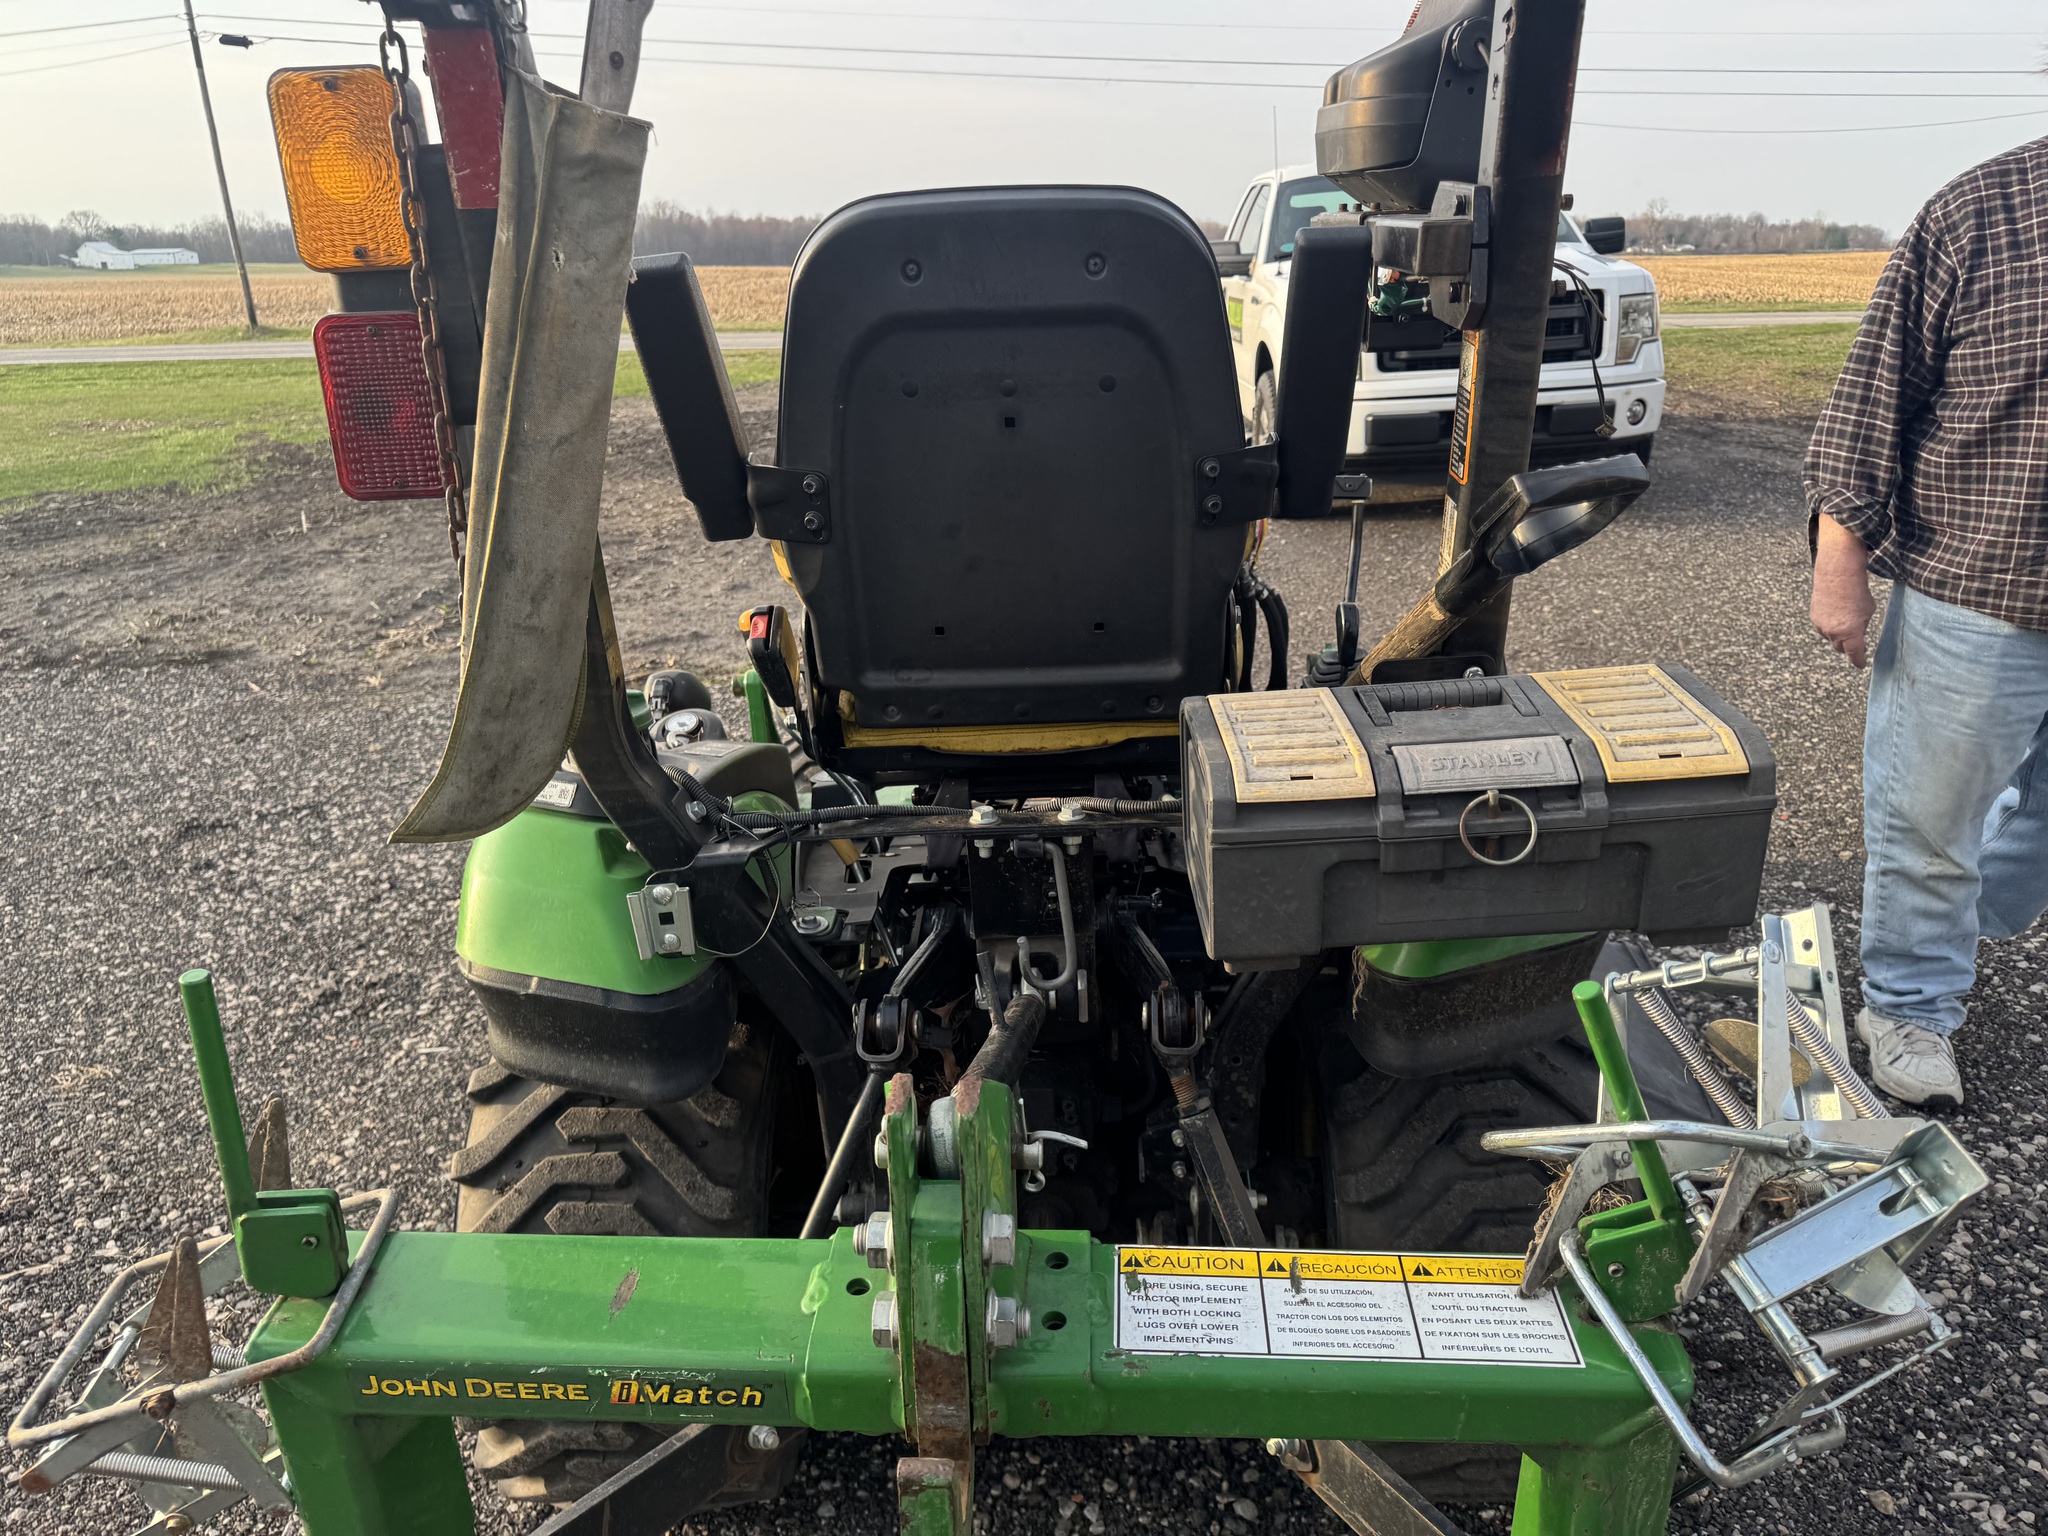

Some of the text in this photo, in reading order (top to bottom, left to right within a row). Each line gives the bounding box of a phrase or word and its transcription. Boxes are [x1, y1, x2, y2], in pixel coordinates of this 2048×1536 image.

[1428, 749, 1540, 772] STANLEY
[1147, 1255, 1244, 1270] CAUTION
[1289, 1262, 1397, 1275] RECAUCIÓN
[1134, 1281, 1248, 1292] ORE USING, SECURE
[1131, 1294, 1242, 1304] TRACTOR IMPLEMENT
[1137, 1321, 1166, 1329] LUGS
[1144, 1335, 1206, 1343] IMPLEMENT
[1442, 1344, 1502, 1352] INFÉRIEURES
[362, 1376, 458, 1397] JOHN
[464, 1378, 590, 1400] DEERE
